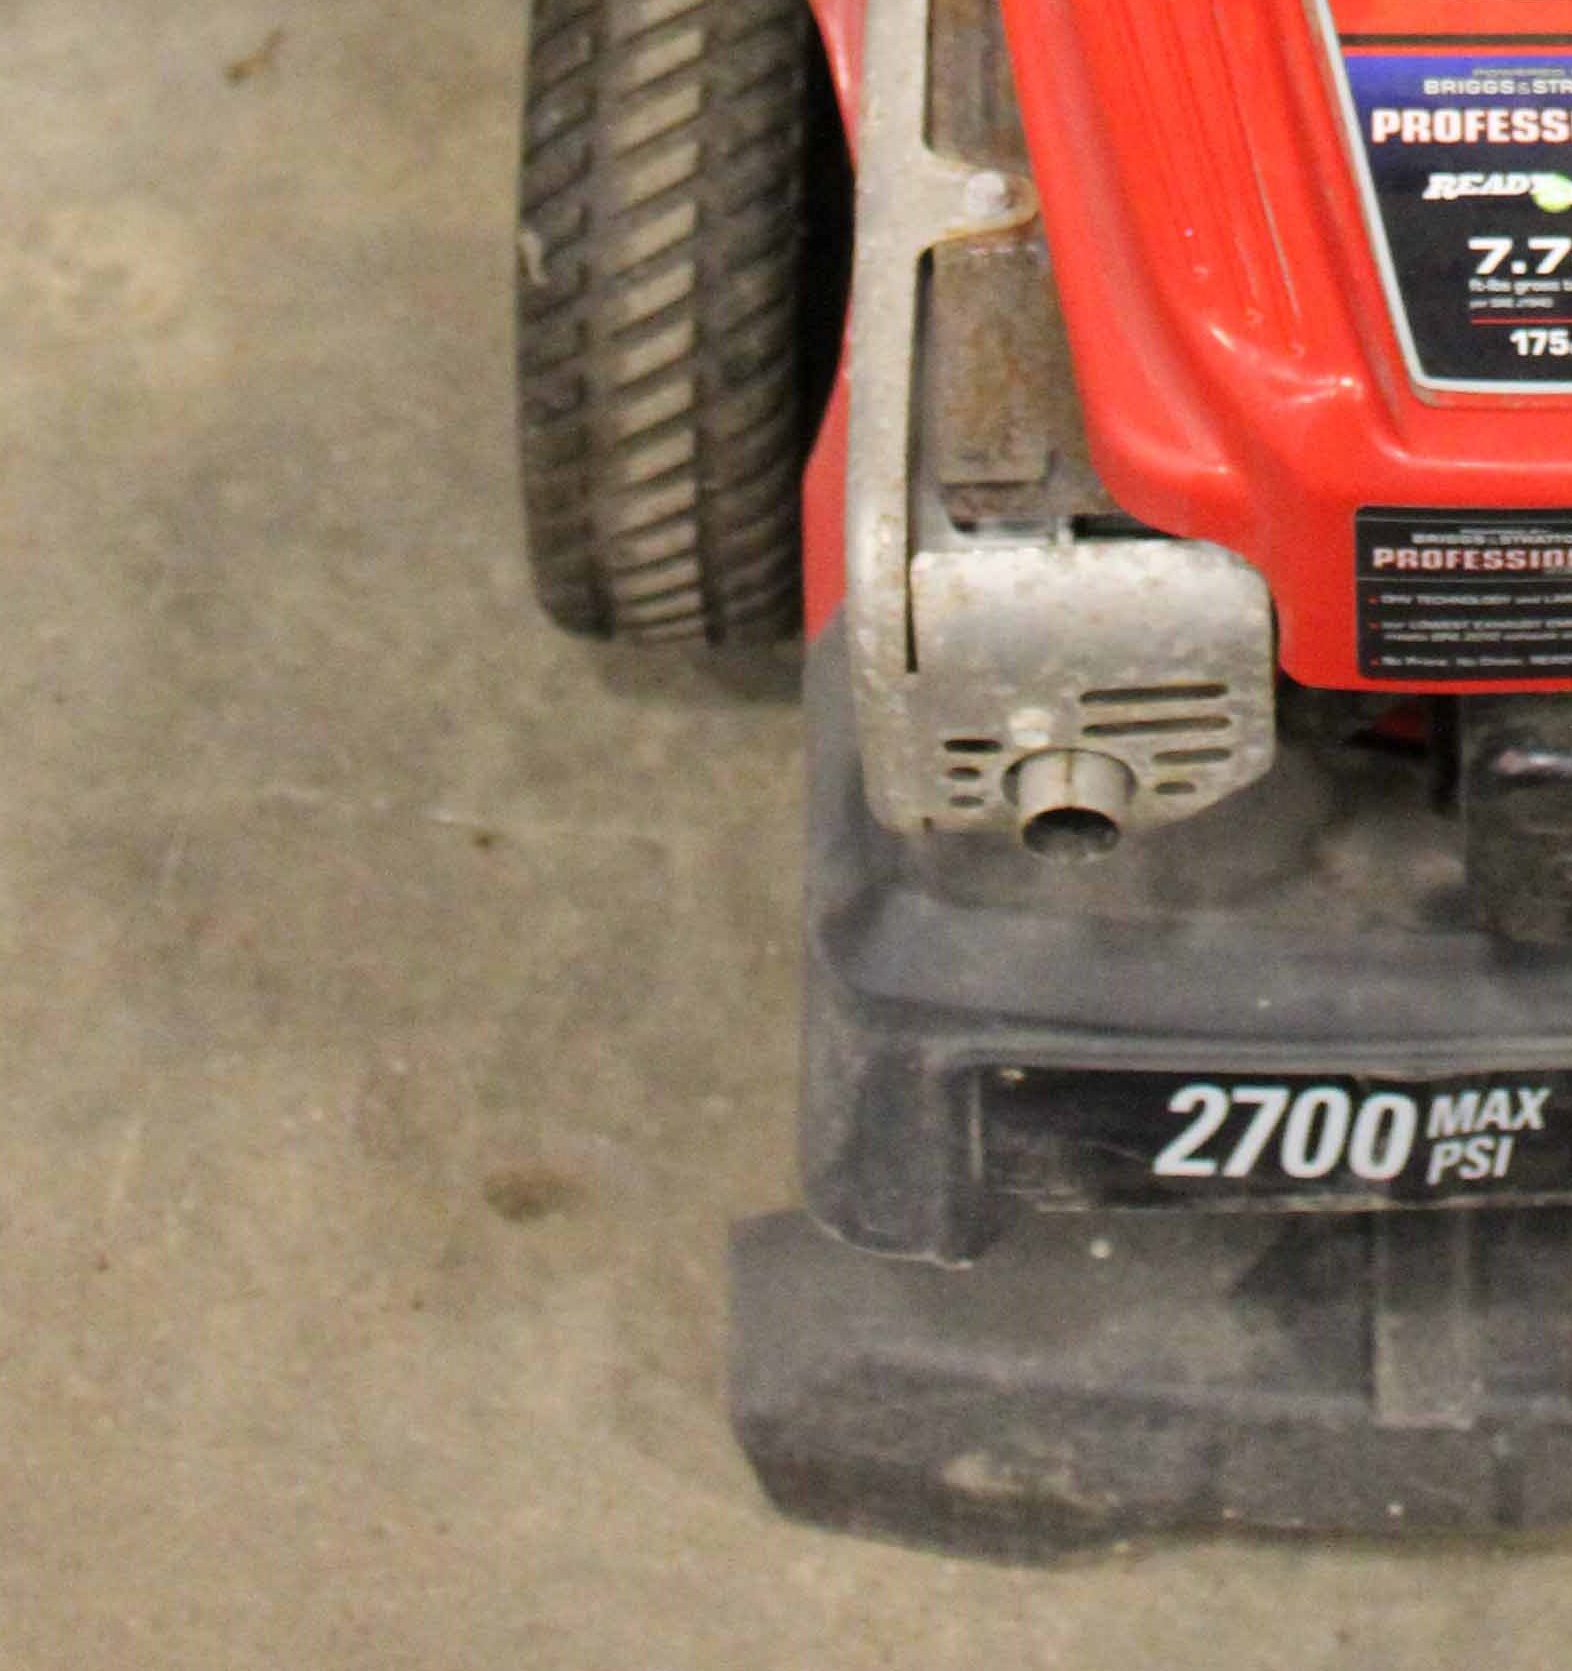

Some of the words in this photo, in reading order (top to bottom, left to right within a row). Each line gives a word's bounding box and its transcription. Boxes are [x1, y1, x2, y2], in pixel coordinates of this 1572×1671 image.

[1153, 1085, 1416, 1180] 2700
[1426, 1088, 1552, 1139] MAX
[1426, 1134, 1513, 1185] PSI
